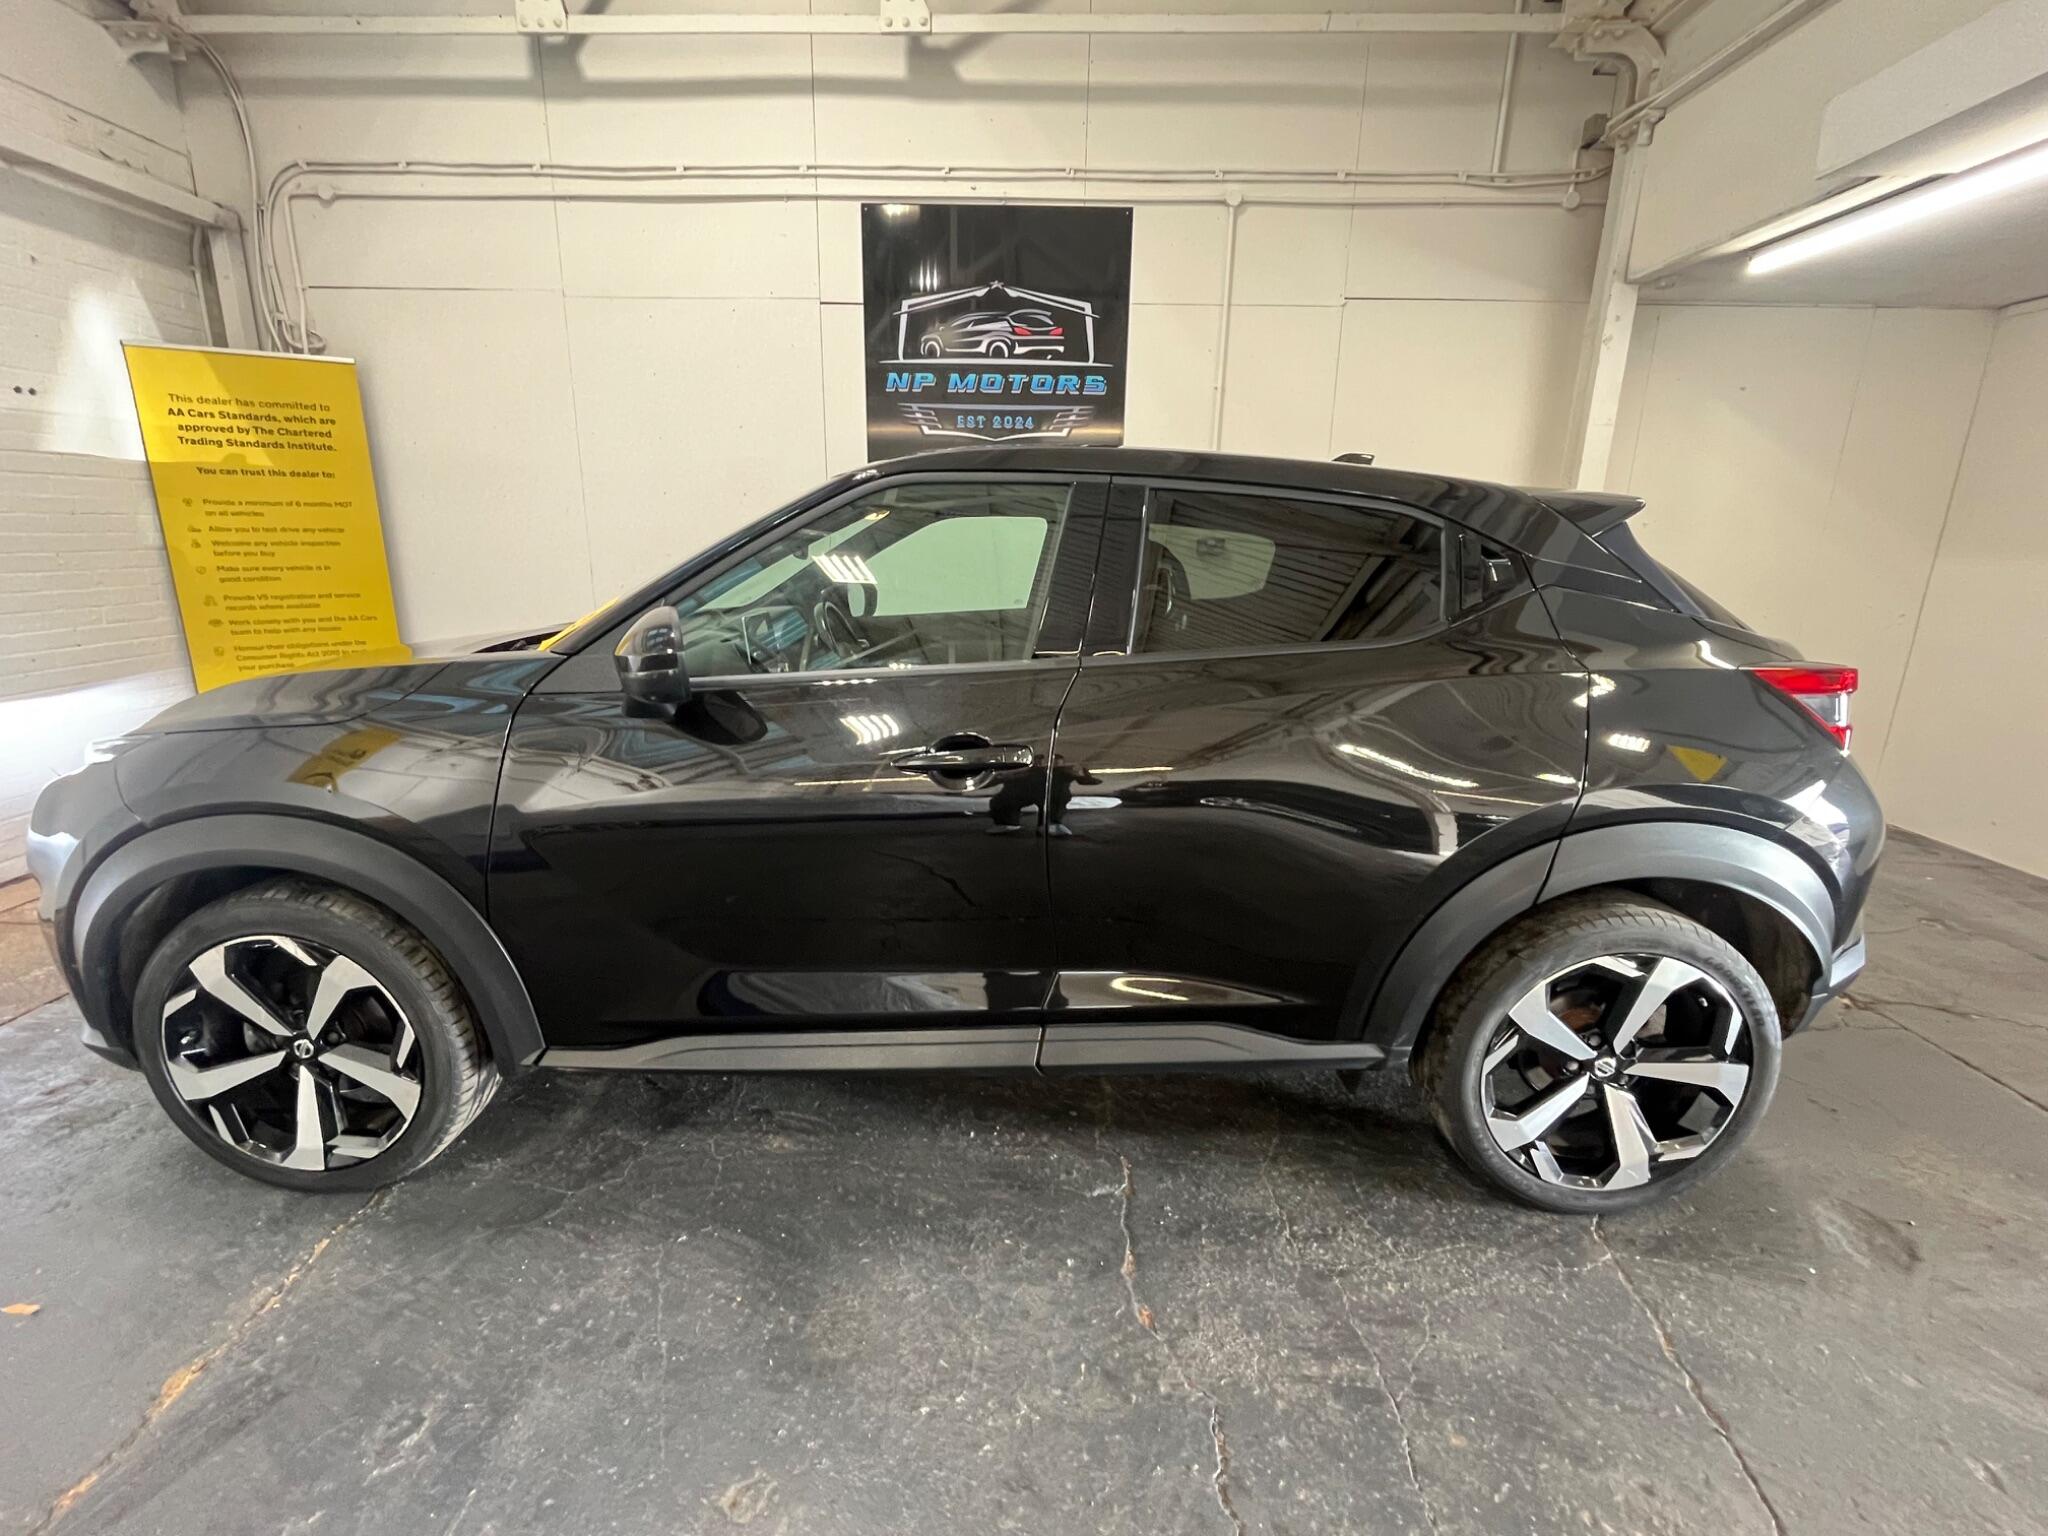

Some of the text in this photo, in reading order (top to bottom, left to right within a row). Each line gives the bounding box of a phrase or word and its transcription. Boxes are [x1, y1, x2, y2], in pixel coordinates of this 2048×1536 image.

[886, 372, 1108, 395] NP MOTORS
[168, 393, 330, 412] This dealer has committed to
[168, 408, 184, 417] AA
[188, 409, 215, 419] Cars
[218, 411, 281, 423] Standards,
[284, 415, 316, 424] which
[957, 415, 1034, 428] EST 2024
[178, 423, 332, 438] approved by The Chartered
[178, 436, 337, 451] Trading Standards Institute.
[196, 467, 336, 479] You can trust this dealer to:
[270, 592, 316, 601] registration
[252, 618, 281, 626] closely
[302, 626, 316, 634] any
